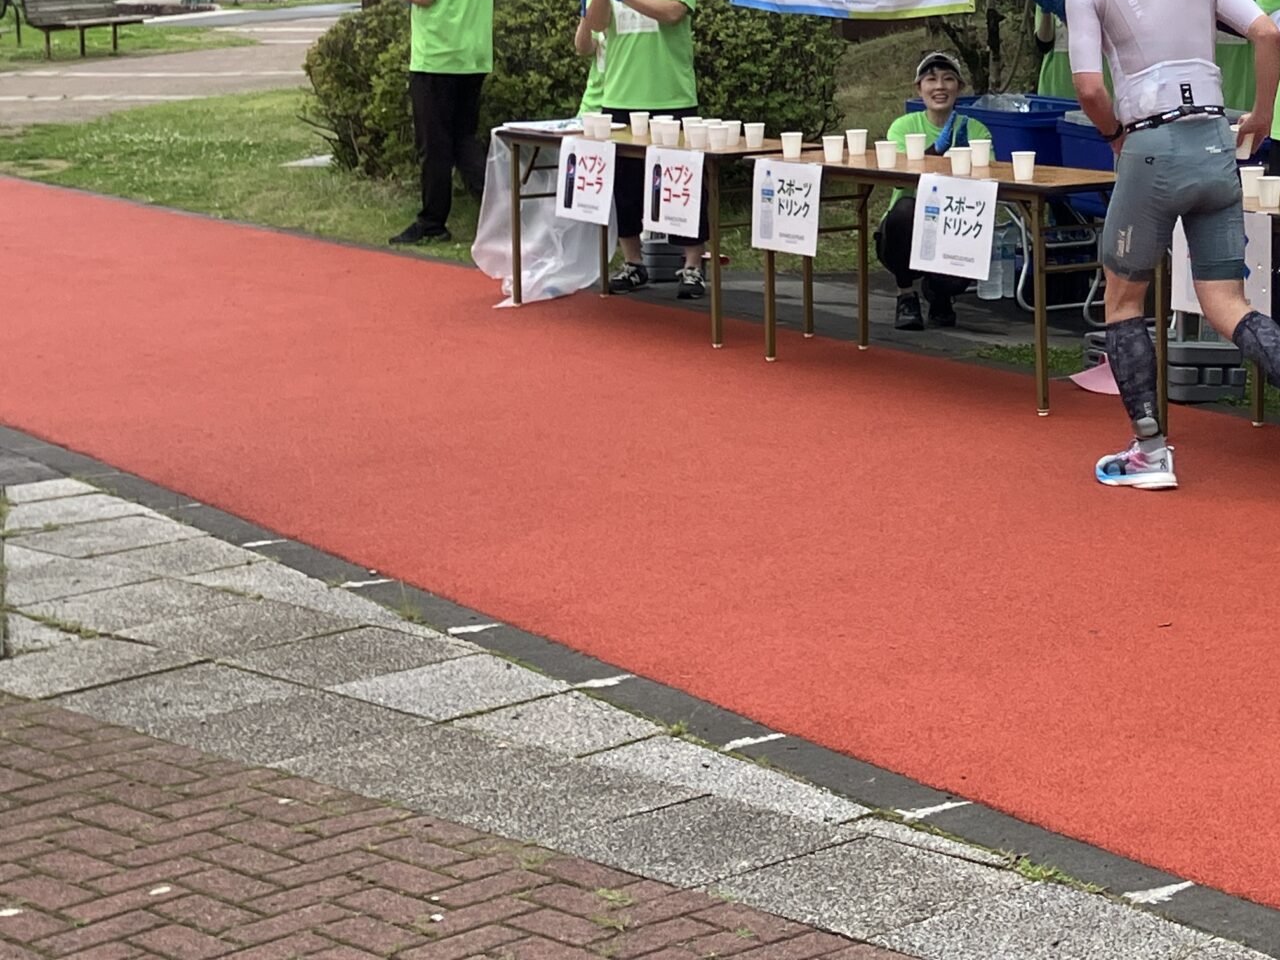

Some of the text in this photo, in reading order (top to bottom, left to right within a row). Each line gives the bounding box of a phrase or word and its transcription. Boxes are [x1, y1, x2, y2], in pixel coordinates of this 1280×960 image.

[578, 154, 606, 174] ペプシ
[577, 176, 603, 194] コーラ
[663, 165, 693, 185] ペプシ
[663, 188, 690, 206] コーラ
[777, 179, 812, 198] スポーツ
[778, 198, 810, 218] ドリンク
[943, 196, 986, 217] スポーツ
[943, 216, 983, 239] ドリンク
